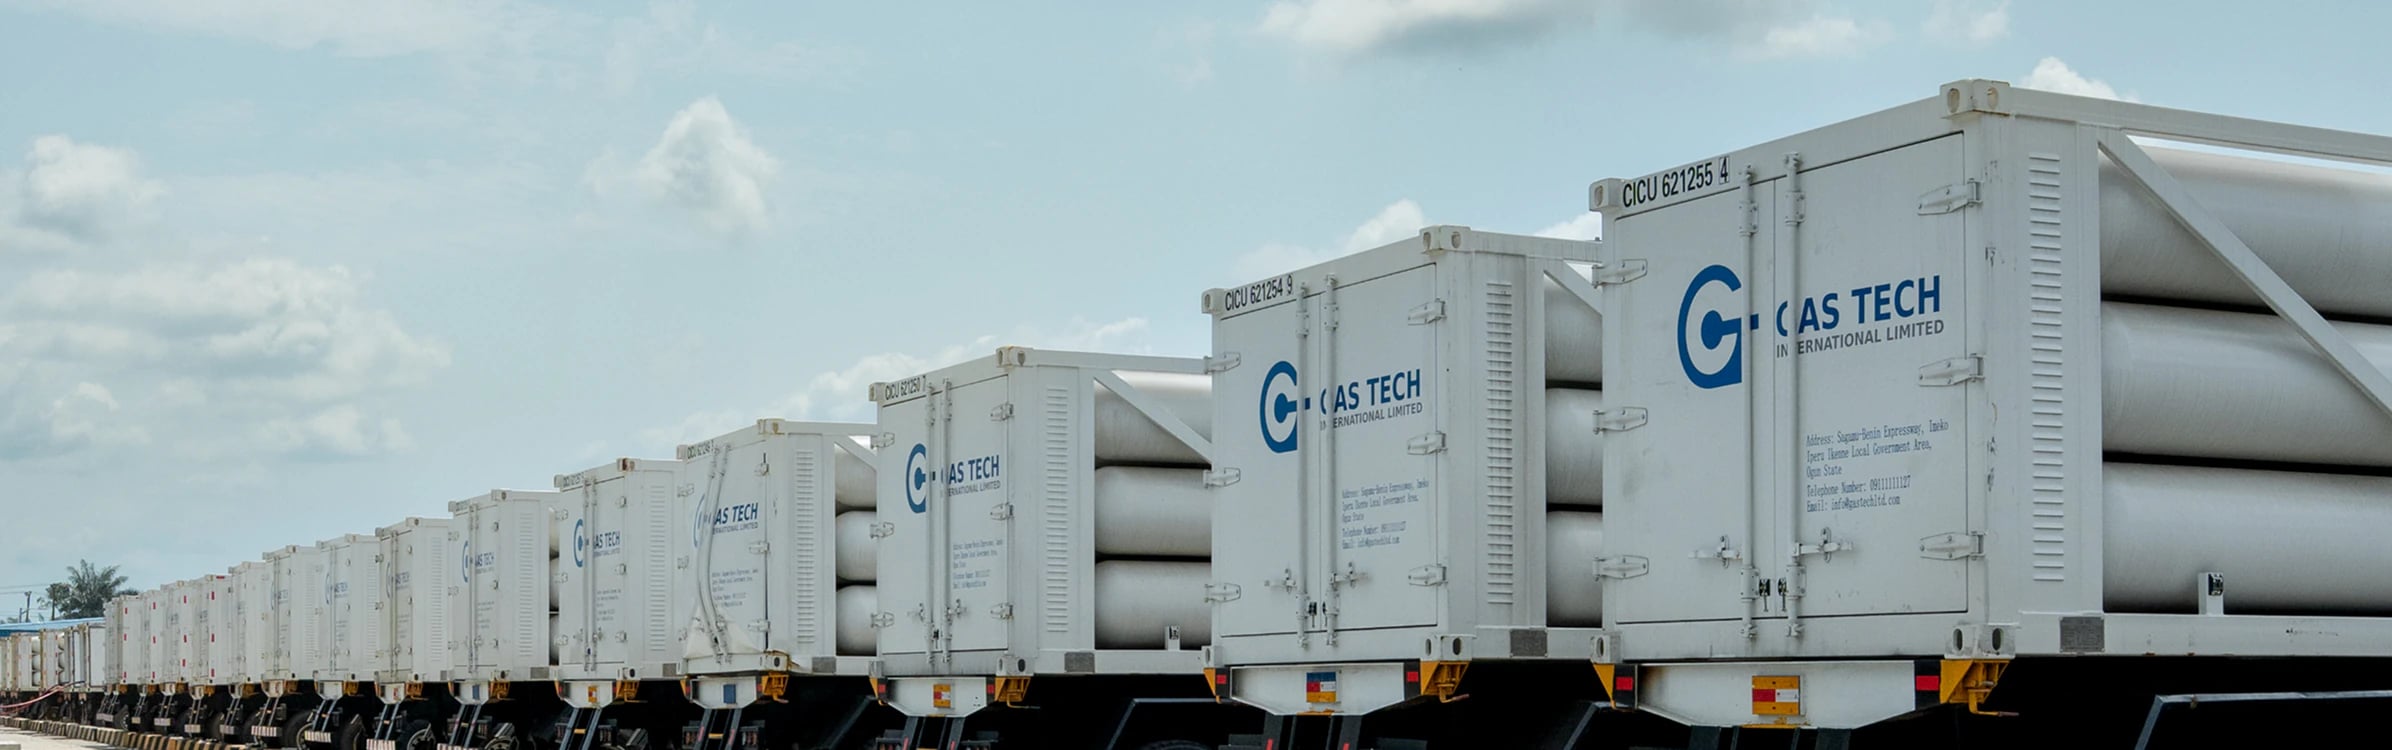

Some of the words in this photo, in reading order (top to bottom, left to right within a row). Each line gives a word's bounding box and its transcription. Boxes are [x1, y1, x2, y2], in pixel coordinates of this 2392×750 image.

[1623, 175, 1657, 208] CICU
[1662, 161, 1713, 198] 621255
[1719, 158, 1730, 183] 4
[1225, 288, 1247, 311] CICU
[1250, 279, 1283, 304] 621254
[1287, 275, 1293, 294] 9
[1851, 275, 1940, 324] TECH
[1777, 329, 1881, 358] INERNATIONAL
[1886, 319, 1944, 341] LIMITED
[1366, 369, 1420, 406] TECH
[1388, 402, 1422, 418] LIMITED
[1806, 434, 1834, 447] Address:
[1884, 424, 1924, 439] Expressway,
[1851, 444, 1869, 457] Local
[1872, 442, 1910, 454] Government
[941, 461, 964, 484] AS
[968, 455, 999, 480] TECH
[1824, 464, 1842, 476] State
[1807, 484, 1838, 498] Telephone
[1841, 481, 1866, 494] Number:
[709, 507, 728, 525] AS
[732, 502, 758, 522] TECH
[1807, 499, 1827, 512] Email:
[593, 534, 603, 549] AS
